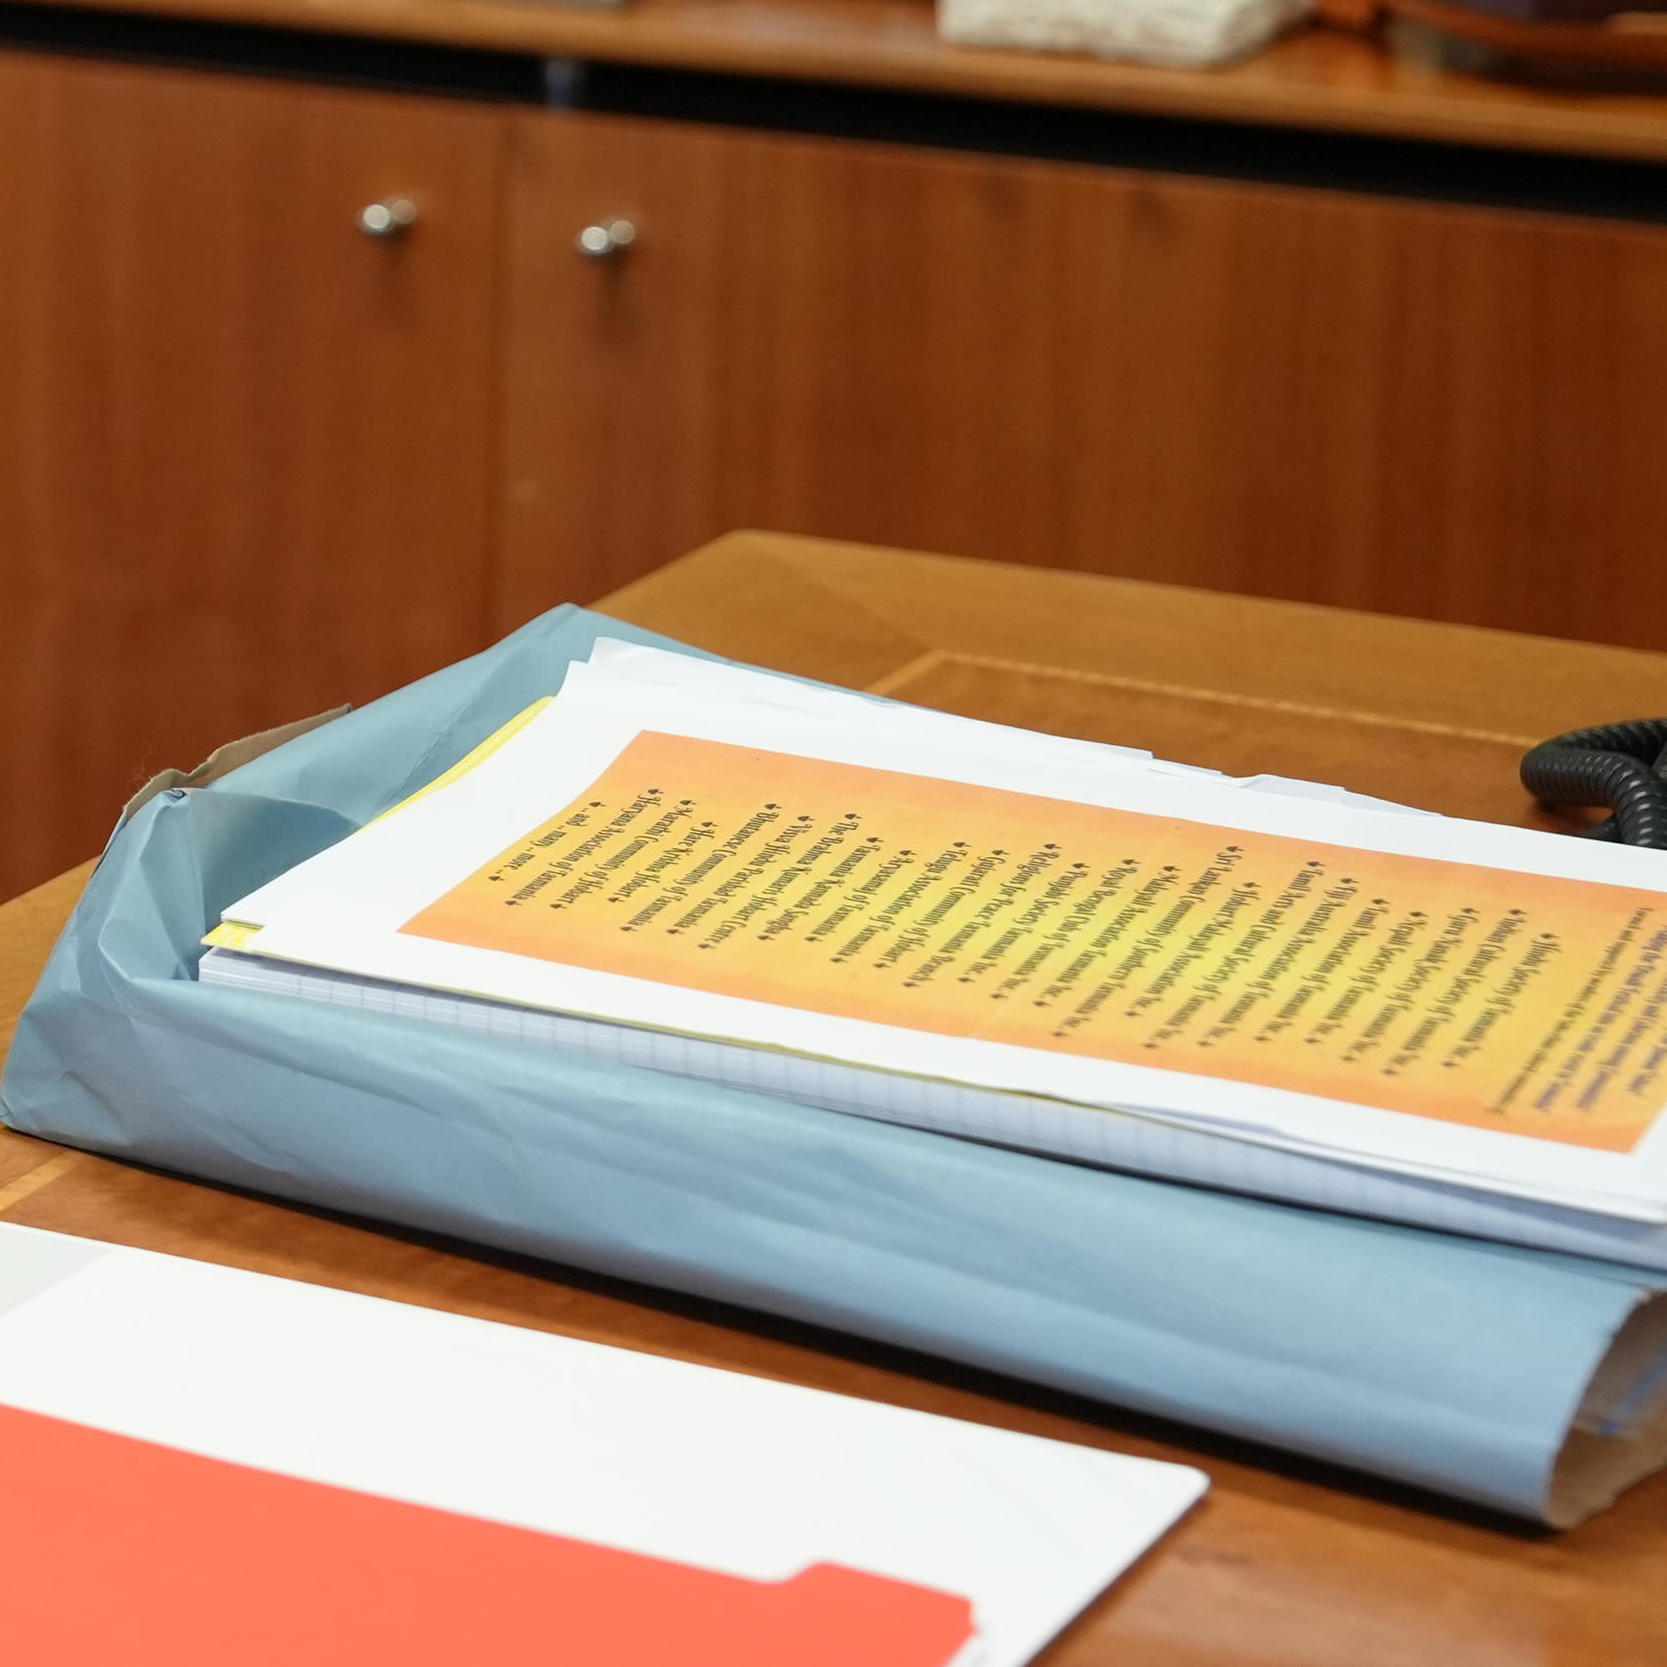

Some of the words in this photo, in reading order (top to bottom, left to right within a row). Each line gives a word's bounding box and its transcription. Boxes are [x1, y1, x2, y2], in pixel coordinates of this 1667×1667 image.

[563, 812, 590, 827] and
[609, 793, 662, 827] Haryana
[643, 804, 694, 837] Marathi
[529, 829, 568, 847] many
[560, 824, 626, 863] Association
[676, 825, 716, 847] Hare
[721, 810, 780, 850] Bhutanese
[772, 822, 813, 844] Visva
[827, 820, 860, 836] The
[502, 851, 536, 871] more
[547, 860, 574, 872] of
[593, 834, 660, 872] Community
[643, 846, 694, 873] Krishna
[747, 841, 791, 867] Hindu
[794, 835, 844, 866] Brahma
[827, 843, 882, 878] Tasmania
[923, 848, 969, 874] Telugu
[1213, 851, 1243, 867] Sri
[582, 869, 610, 882] of
[672, 847, 738, 887] Community
[711, 866, 765, 898] Parishad
[760, 865, 813, 896] Kumaris
[851, 854, 915, 896] Aryasamaj
[957, 855, 1006, 888] Gujarati
[1008, 850, 1060, 886] Religions
[1098, 865, 1138, 890] Royal
[1185, 865, 1232, 896] Lankan
[510, 868, 568, 901] Tasmania
[555, 876, 604, 905] Hobart
[612, 870, 661, 898] Hobart
[661, 885, 689, 897] of
[791, 877, 845, 910] Kannada
[841, 893, 871, 906] of
[880, 871, 943, 915] Association
[997, 881, 1028, 898] for
[1041, 869, 1089, 900] Punjabi
[625, 894, 683, 926] Tasmania
[671, 896, 729, 929] Tasmania
[730, 893, 778, 922] Hobart
[911, 885, 976, 928] Community
[973, 897, 1015, 920] Peace
[1011, 897, 1061, 926] Society
[1071, 888, 1117, 916] Bengal
[1144, 894, 1206, 938] Community
[1214, 887, 1260, 919] Hobart
[1258, 907, 1284, 926] and
[703, 919, 747, 944] Centre
[762, 907, 810, 935] Sangha
[809, 903, 865, 936] Tasmania
[867, 913, 896, 926] of
[901, 926, 931, 938] of
[1055, 914, 1091, 933] Club
[1087, 903, 1148, 949] Association
[835, 923, 891, 957] Tasmania
[877, 933, 926, 963] Hobart
[936, 919, 991, 954] Tasmania
[979, 925, 1033, 961] Tasmania
[1041, 931, 1071, 943] of
[1134, 936, 1164, 949] of
[1230, 923, 1277, 958] Cultural
[907, 954, 956, 982] Branch
[1011, 940, 1065, 976] Tasmania
[1054, 948, 1107, 984] Tasmania
[1107, 944, 1160, 981] Southern
[1143, 950, 1204, 995] Association
[1202, 954, 1251, 984] Society
[1257, 935, 1316, 981] Association
[1073, 980, 1126, 1015] Tasmania
[1191, 982, 1222, 996] of
[1244, 979, 1275, 993] of
[1163, 992, 1216, 1027] Tasmania
[1217, 989, 1270, 1025] Tasmania
